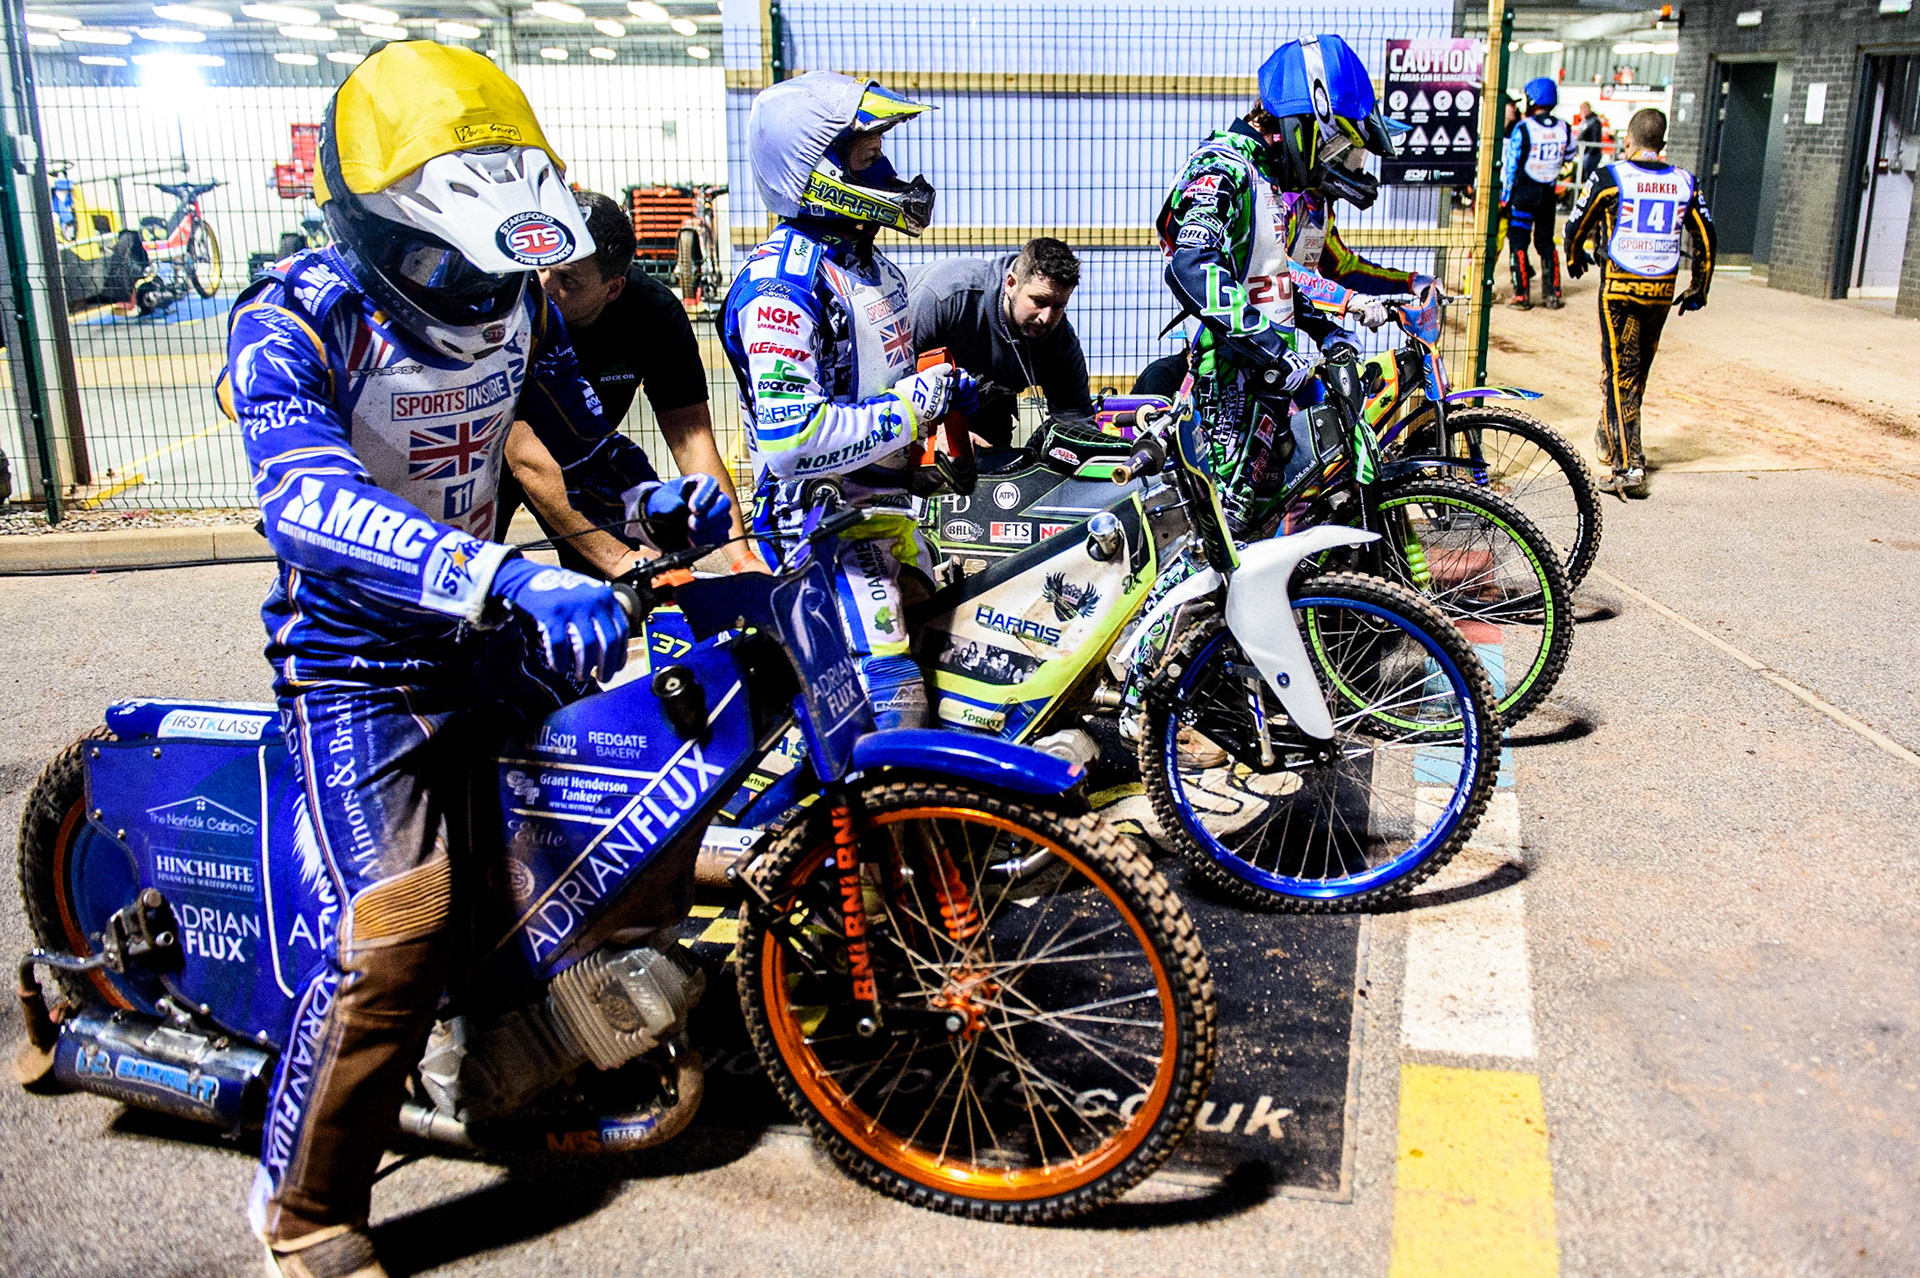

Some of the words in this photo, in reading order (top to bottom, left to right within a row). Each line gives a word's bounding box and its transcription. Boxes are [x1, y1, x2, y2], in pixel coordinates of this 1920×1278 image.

[1390, 48, 1478, 73] CAUTION
[1542, 143, 1559, 160] 12
[805, 176, 900, 225] HARRIS
[1637, 183, 1678, 195] BARKER
[499, 212, 555, 235] STAKEFORD
[1646, 201, 1666, 232] 4
[510, 227, 560, 252] STS
[1620, 239, 1655, 250] SPORTS
[514, 254, 539, 265] TYRE
[540, 242, 574, 265] SERVICES
[1247, 272, 1293, 306] 20
[757, 306, 801, 330] NGK
[757, 323, 776, 331] SPARK
[749, 341, 812, 363] KENNY
[350, 365, 424, 378] SYNERGY
[600, 374, 622, 383] ROCK
[396, 391, 465, 418] SPORTS
[467, 374, 508, 410] INSURE
[758, 381, 786, 391] ROCK
[786, 383, 807, 394] OIL
[912, 376, 930, 410] 37
[922, 375, 944, 420] HARRIS
[758, 402, 815, 420] HARRIS
[451, 485, 469, 518] 11
[320, 487, 438, 560] MRC
[276, 519, 308, 541] MARTIN
[307, 530, 348, 555] REYNOLDS
[348, 543, 420, 576] CONSTRUCTION
[974, 606, 1063, 644] HARRIS
[811, 656, 856, 703] ADRIAN
[826, 679, 858, 719] FLUX
[162, 715, 261, 735] FIRSTKLASS
[326, 692, 355, 757] Brady
[588, 730, 648, 749] REDGATE
[595, 745, 642, 760] BAKERY
[325, 756, 359, 788] &
[539, 773, 569, 788] Grant
[571, 776, 629, 794] Henderson
[561, 788, 603, 803] Tankers
[150, 812, 166, 824] The
[166, 812, 204, 828] Norfolk
[340, 788, 384, 879] Minors
[155, 854, 254, 884] HINCHLIFFE
[185, 930, 246, 964] FLUX
[269, 1091, 301, 1172] FLUX
